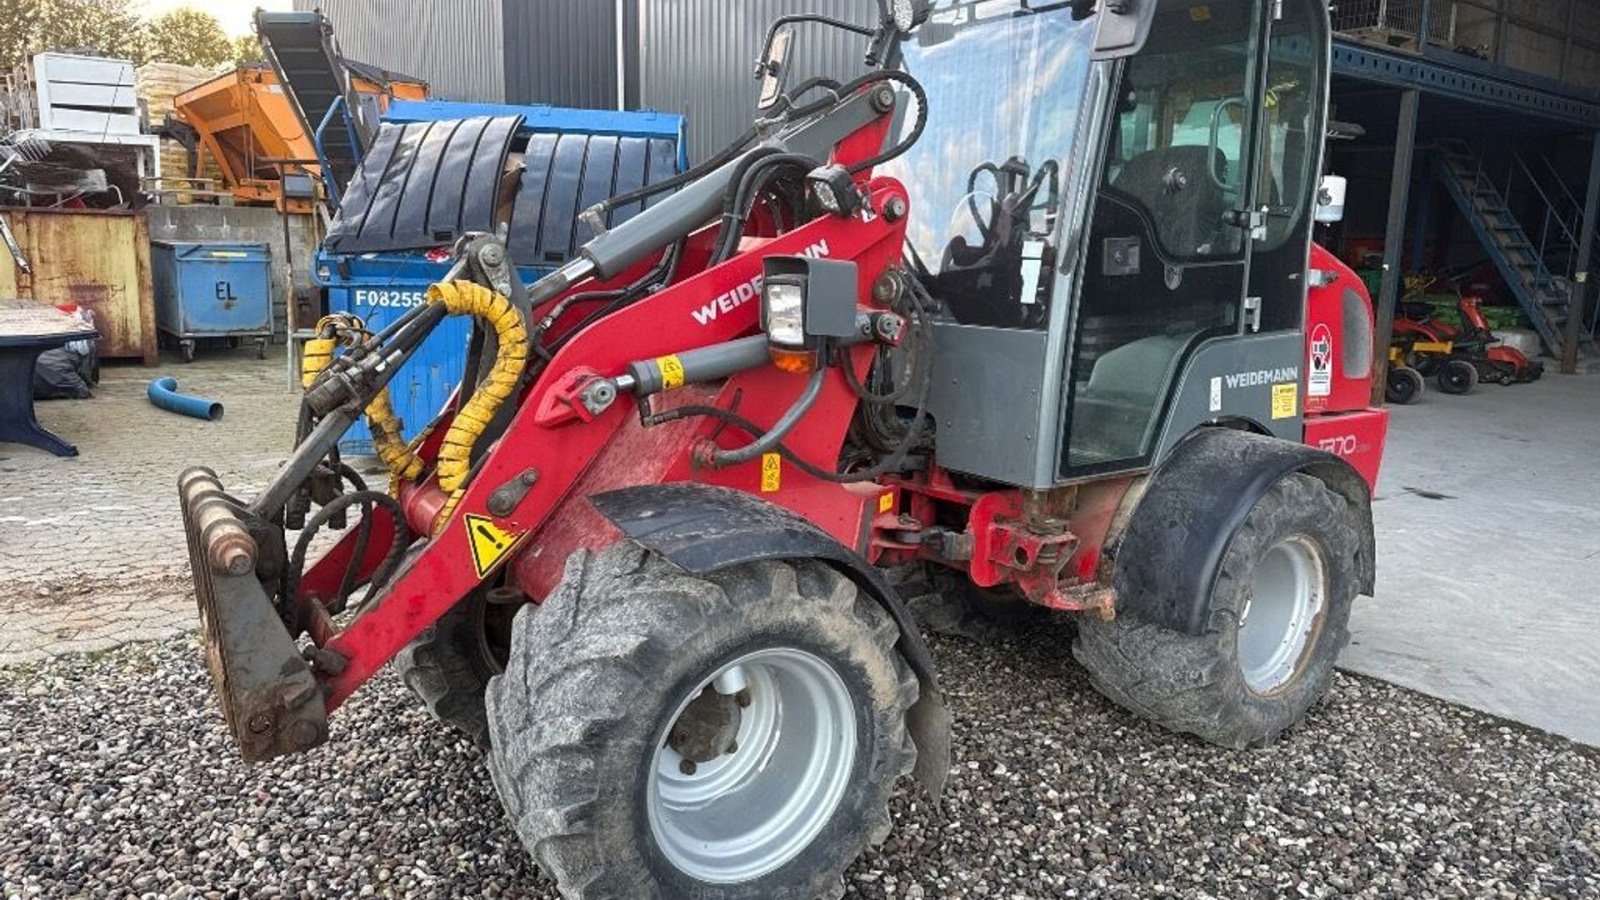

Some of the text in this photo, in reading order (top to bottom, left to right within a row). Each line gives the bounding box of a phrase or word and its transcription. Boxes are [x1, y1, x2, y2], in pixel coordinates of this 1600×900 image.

[215, 281, 237, 300] EL
[355, 290, 428, 308] F08255
[1225, 366, 1298, 389] WEIDEMANN
